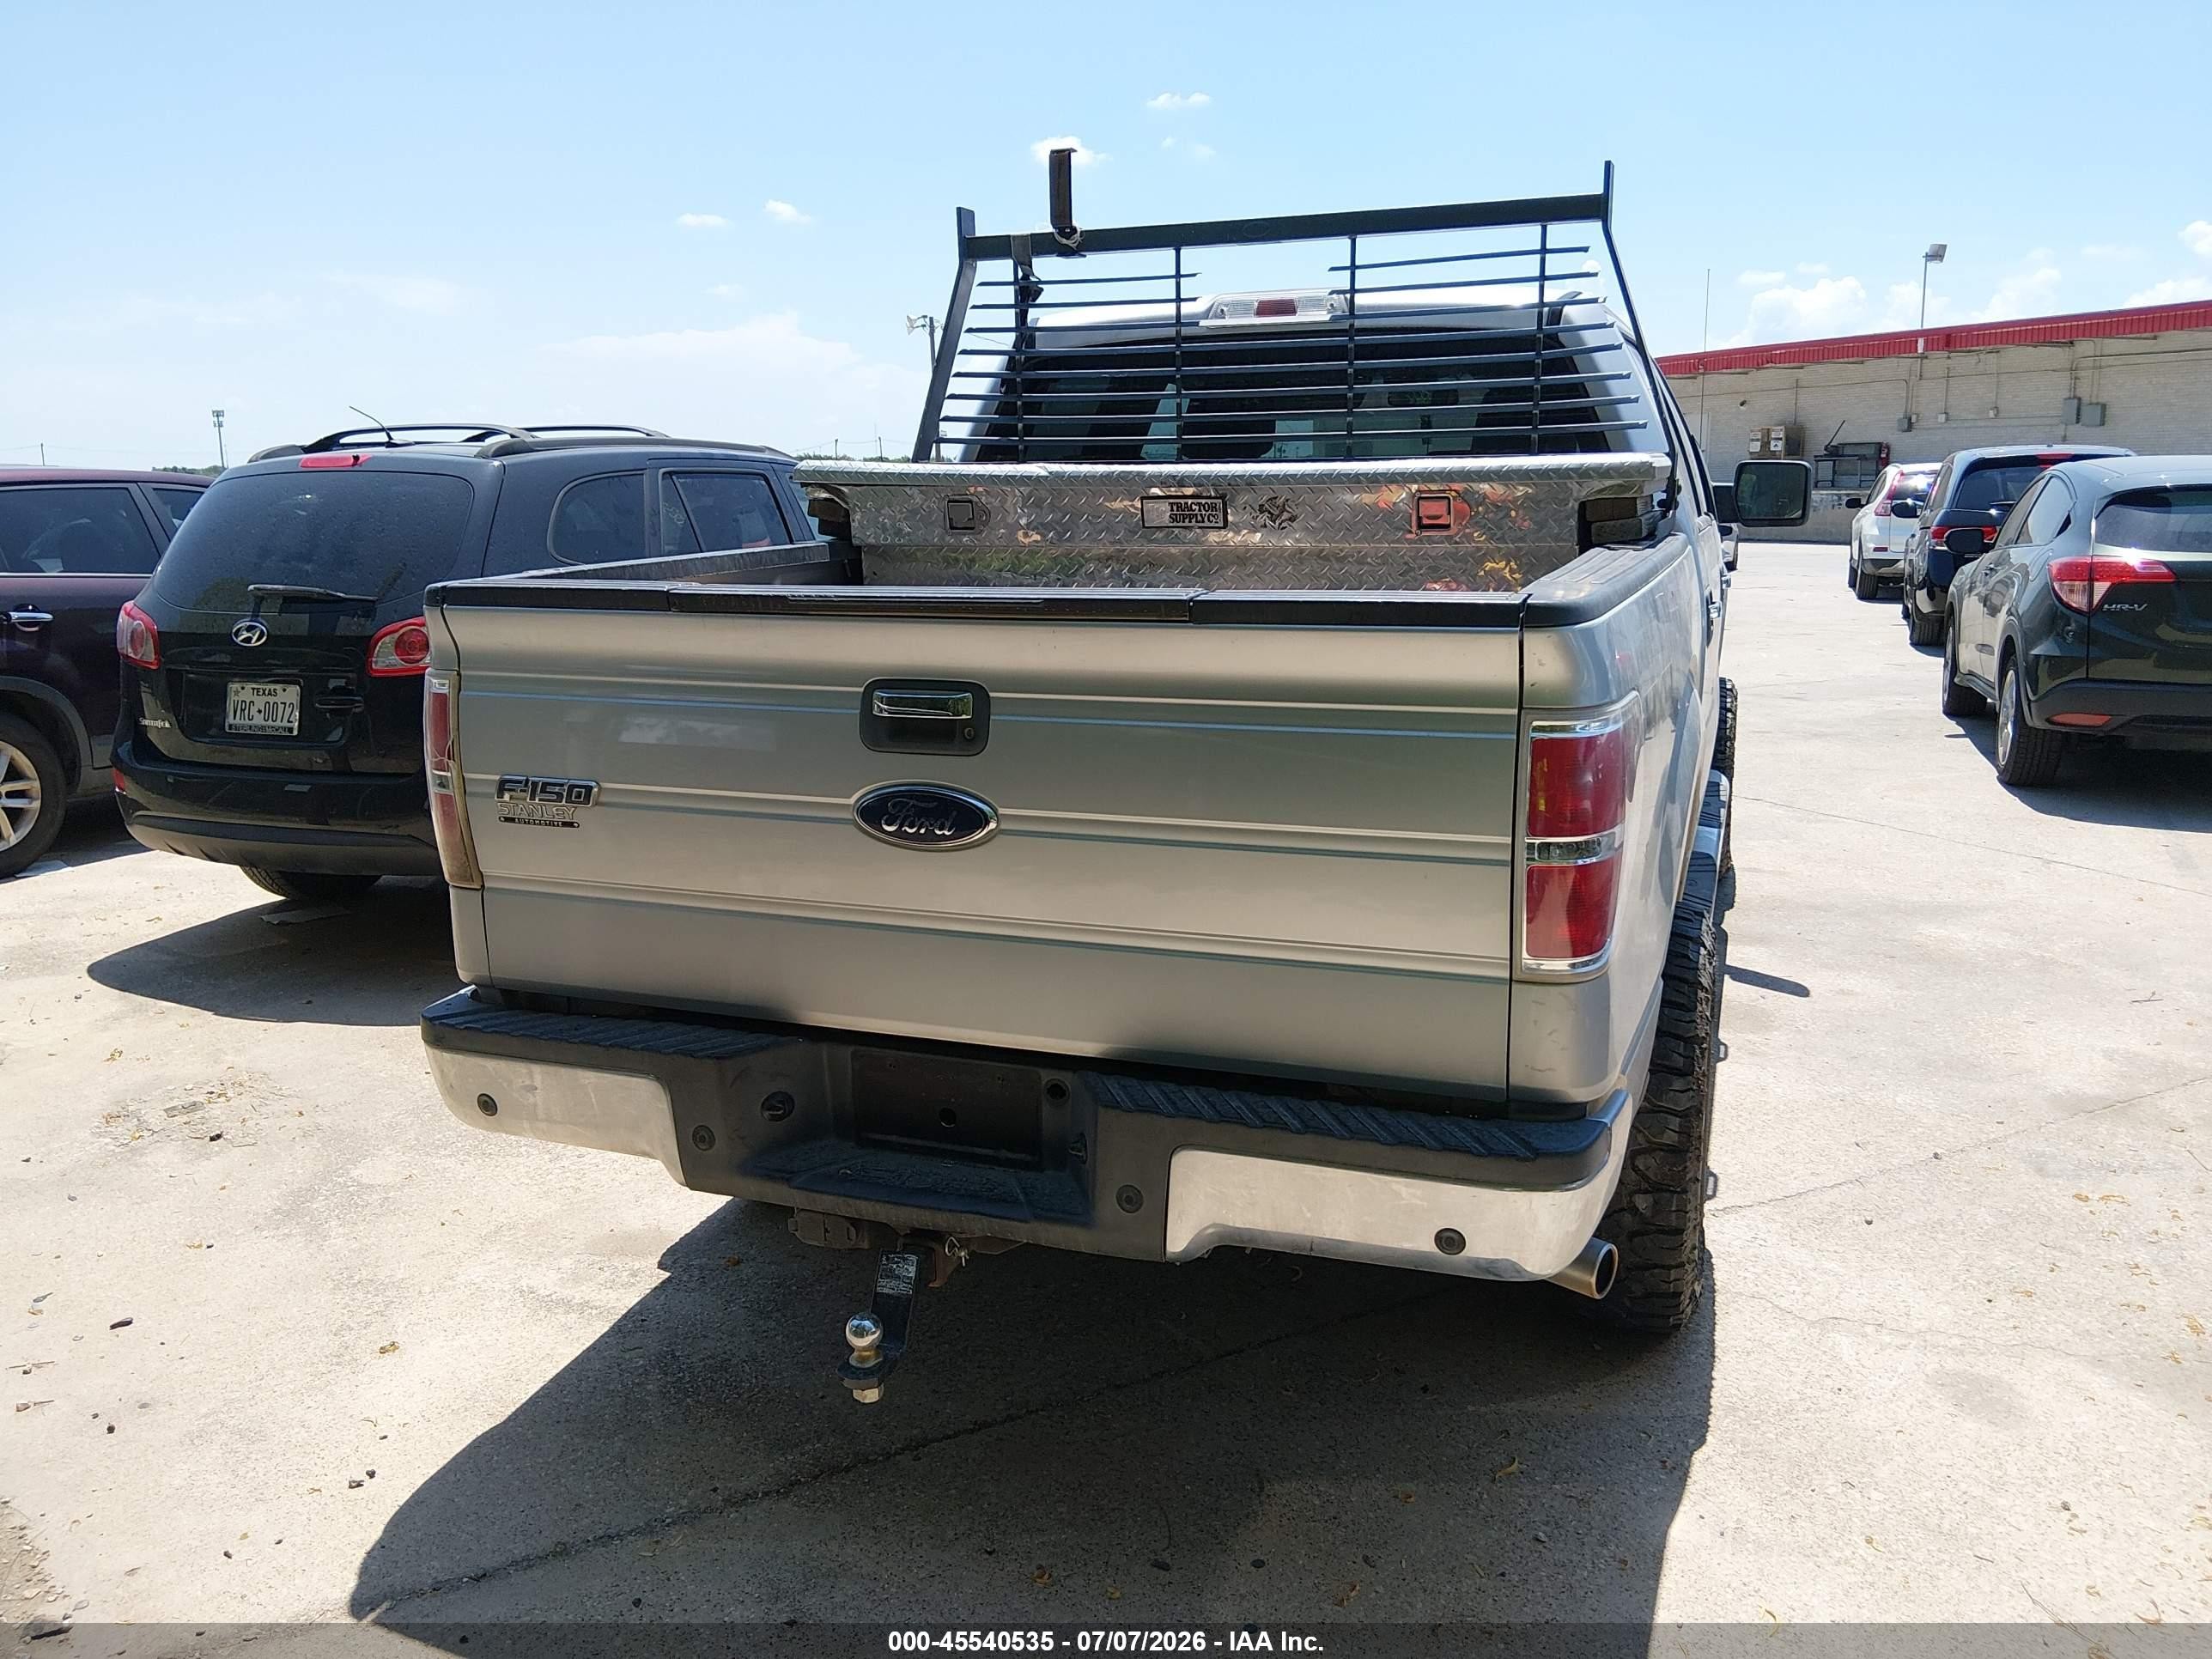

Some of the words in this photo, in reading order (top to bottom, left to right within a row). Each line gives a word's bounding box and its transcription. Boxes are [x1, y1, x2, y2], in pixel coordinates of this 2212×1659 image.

[1169, 501, 1218, 513] TRACTOR
[1169, 513, 1206, 524] SUPPLY
[251, 688, 278, 697] TEXAS
[495, 775, 600, 806] F-150
[497, 802, 577, 821] STANLEY
[881, 799, 957, 836] Ford
[514, 817, 563, 827] AUTOMOTIVE
